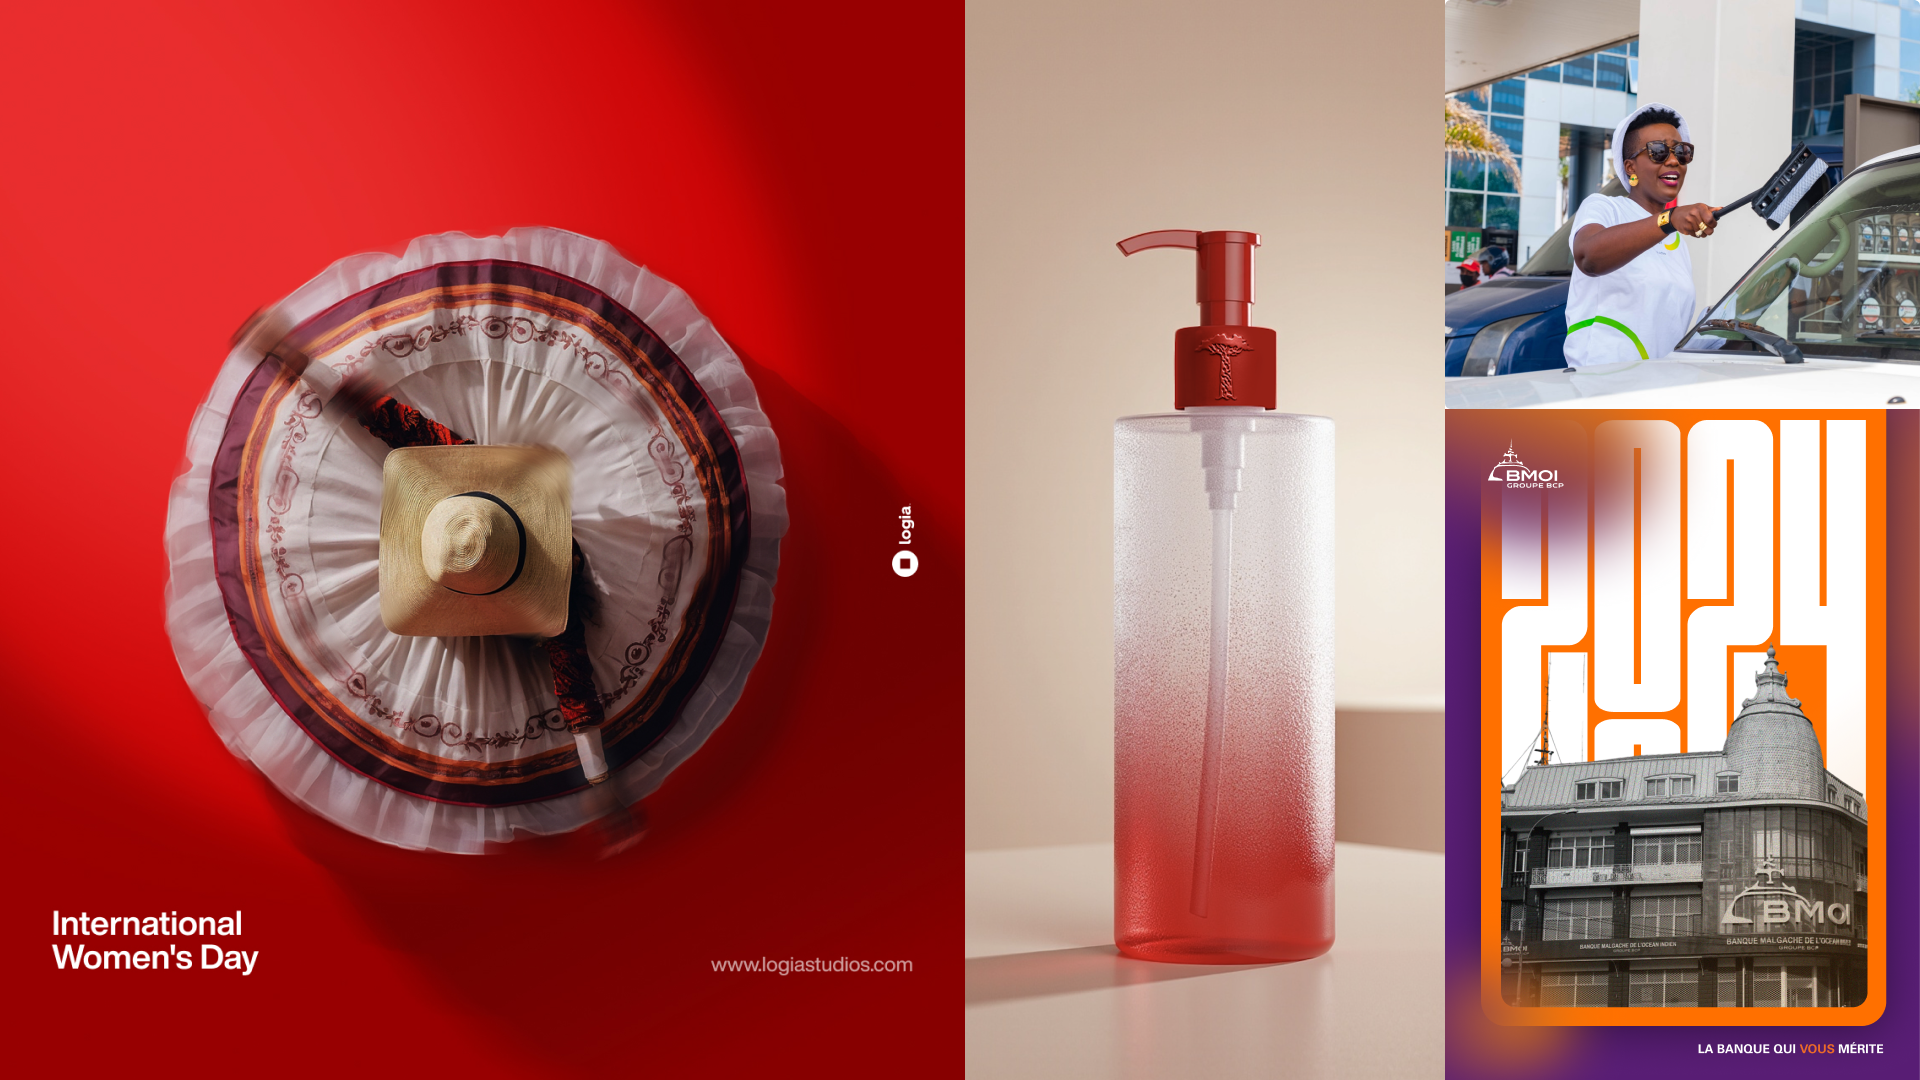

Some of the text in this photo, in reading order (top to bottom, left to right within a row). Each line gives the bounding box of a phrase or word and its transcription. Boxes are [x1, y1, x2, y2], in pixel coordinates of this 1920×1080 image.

[1763, 900, 1851, 925] BMOI
[1726, 937, 1758, 946] BANQUE
[1760, 936, 1803, 944] MALGACHE
[1804, 936, 1815, 944] DE
